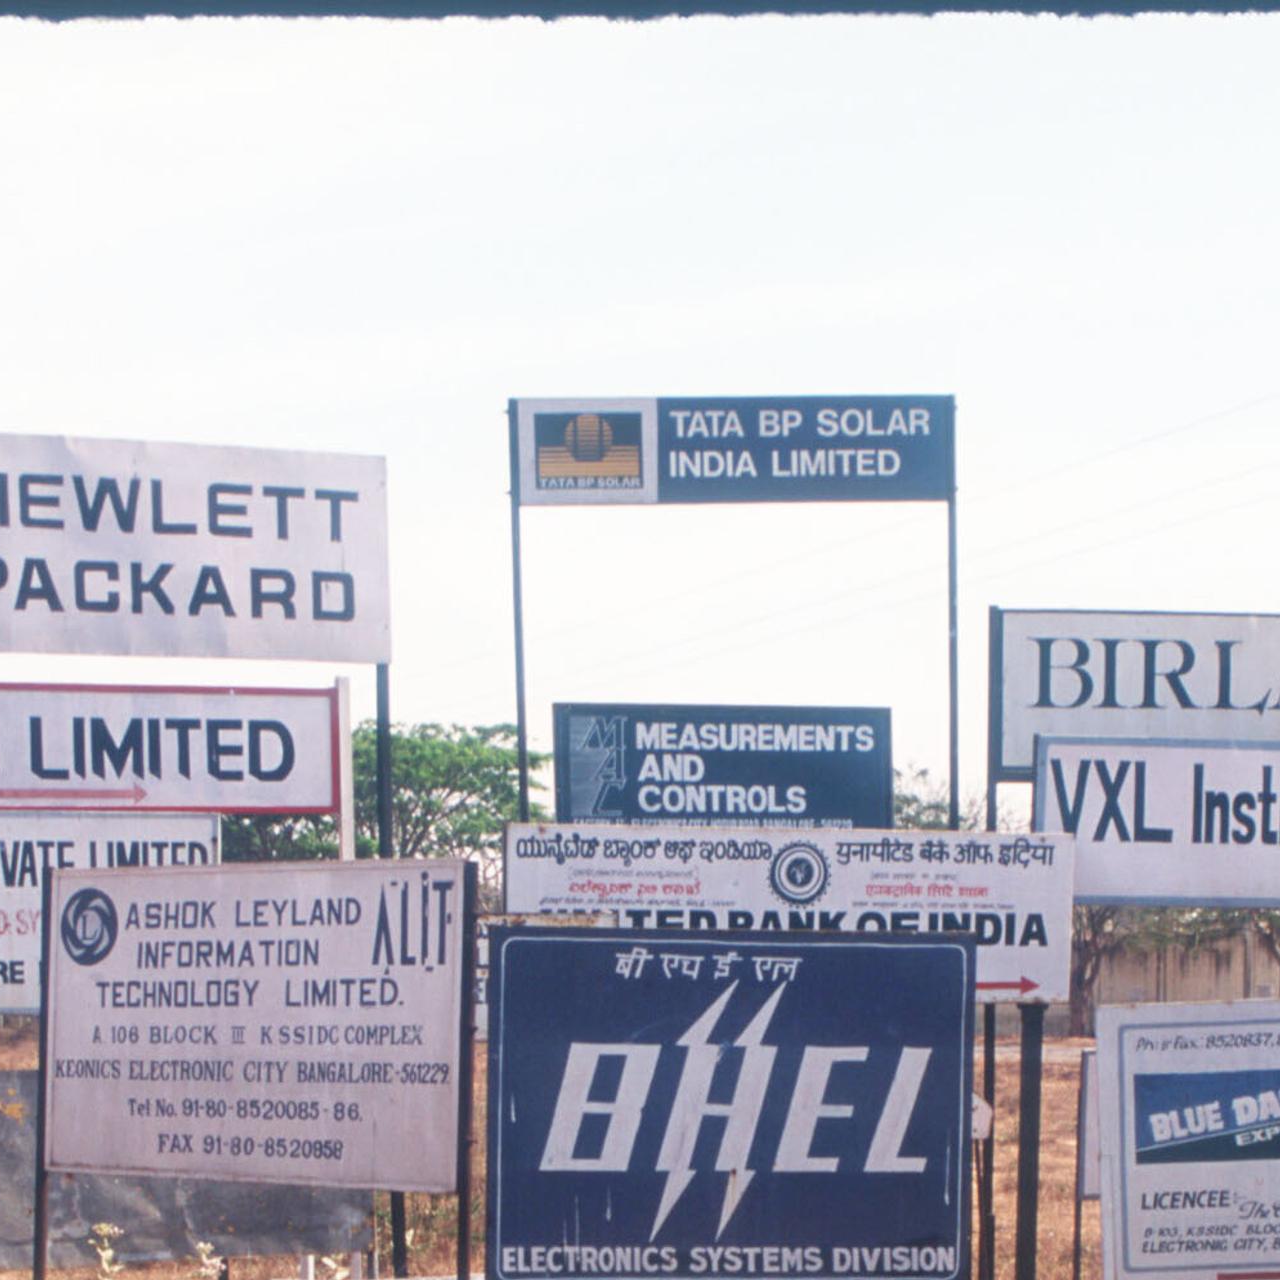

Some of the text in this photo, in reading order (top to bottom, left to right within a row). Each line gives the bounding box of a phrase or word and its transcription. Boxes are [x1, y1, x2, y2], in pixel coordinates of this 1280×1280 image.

[668, 408, 931, 439] TATA BP SOLAR
[668, 448, 902, 479] INDIA LIMITED
[540, 477, 575, 488] TATA
[596, 477, 641, 488] SOLAR
[29, 715, 297, 783] LIMITED
[634, 721, 876, 752] MEASUREMENTS
[637, 753, 706, 782] AND
[637, 785, 808, 814] CONTROLS
[1049, 758, 1174, 844] VXL
[124, 897, 362, 930] ASHOK LEYLAND
[137, 939, 320, 969] INFORMATION
[615, 946, 803, 982] बी एच ई एल
[95, 980, 261, 1008] TECHNOLOGY
[92, 1025, 102, 1044] A
[148, 1025, 219, 1046] BLOCK
[343, 1024, 424, 1047] COMPLEX
[54, 1058, 288, 1084] KEONICS ELECTRONIC CITY
[128, 1098, 151, 1118] Tel
[538, 1042, 933, 1173] BHEL
[1149, 1100, 1225, 1142] BLUE
[157, 1133, 194, 1154] FAX
[1238, 1200, 1271, 1220] The
[502, 1246, 956, 1274] ELECTRONICS SYSTEMS DIVISION
